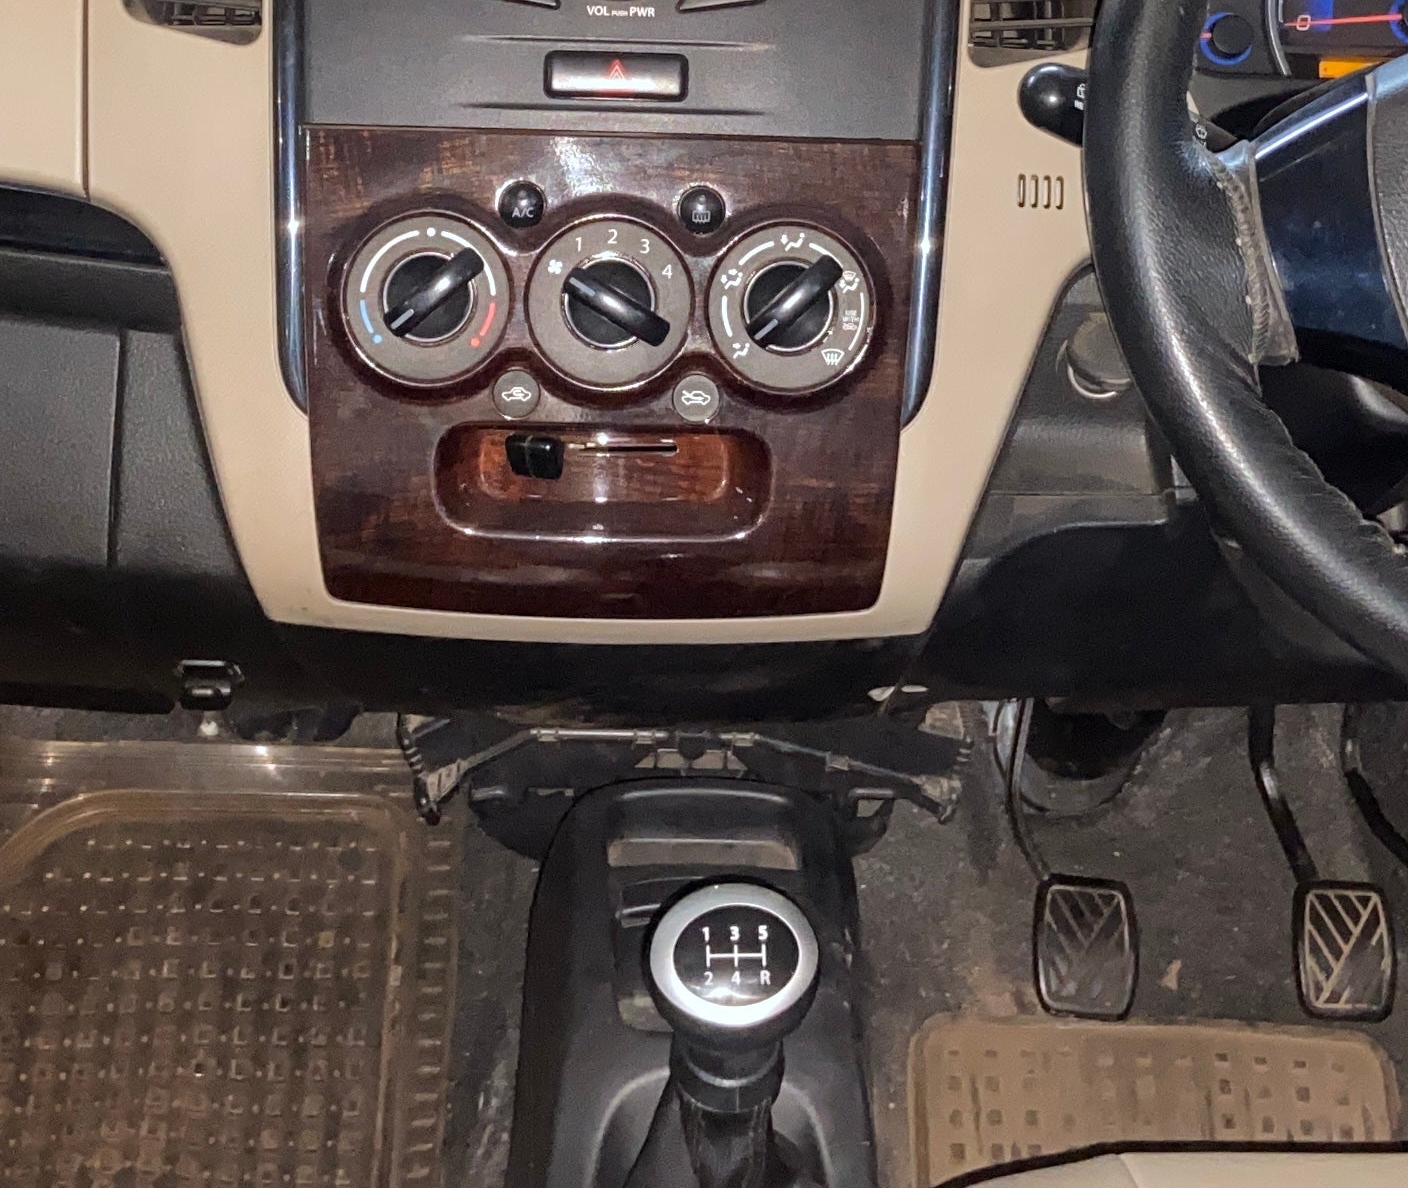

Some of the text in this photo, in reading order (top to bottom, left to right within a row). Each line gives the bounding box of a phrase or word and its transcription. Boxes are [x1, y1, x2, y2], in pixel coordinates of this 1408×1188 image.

[586, 4, 656, 18] VOL PUSH PWR
[1295, 14, 1312, 32] 0
[511, 206, 535, 218] A/C
[575, 236, 582, 252] 1
[607, 228, 618, 245] 2
[639, 238, 650, 254] 3
[661, 263, 673, 280] 4
[702, 925, 768, 942] 1 3 5
[703, 970, 771, 986] 2 4 R
